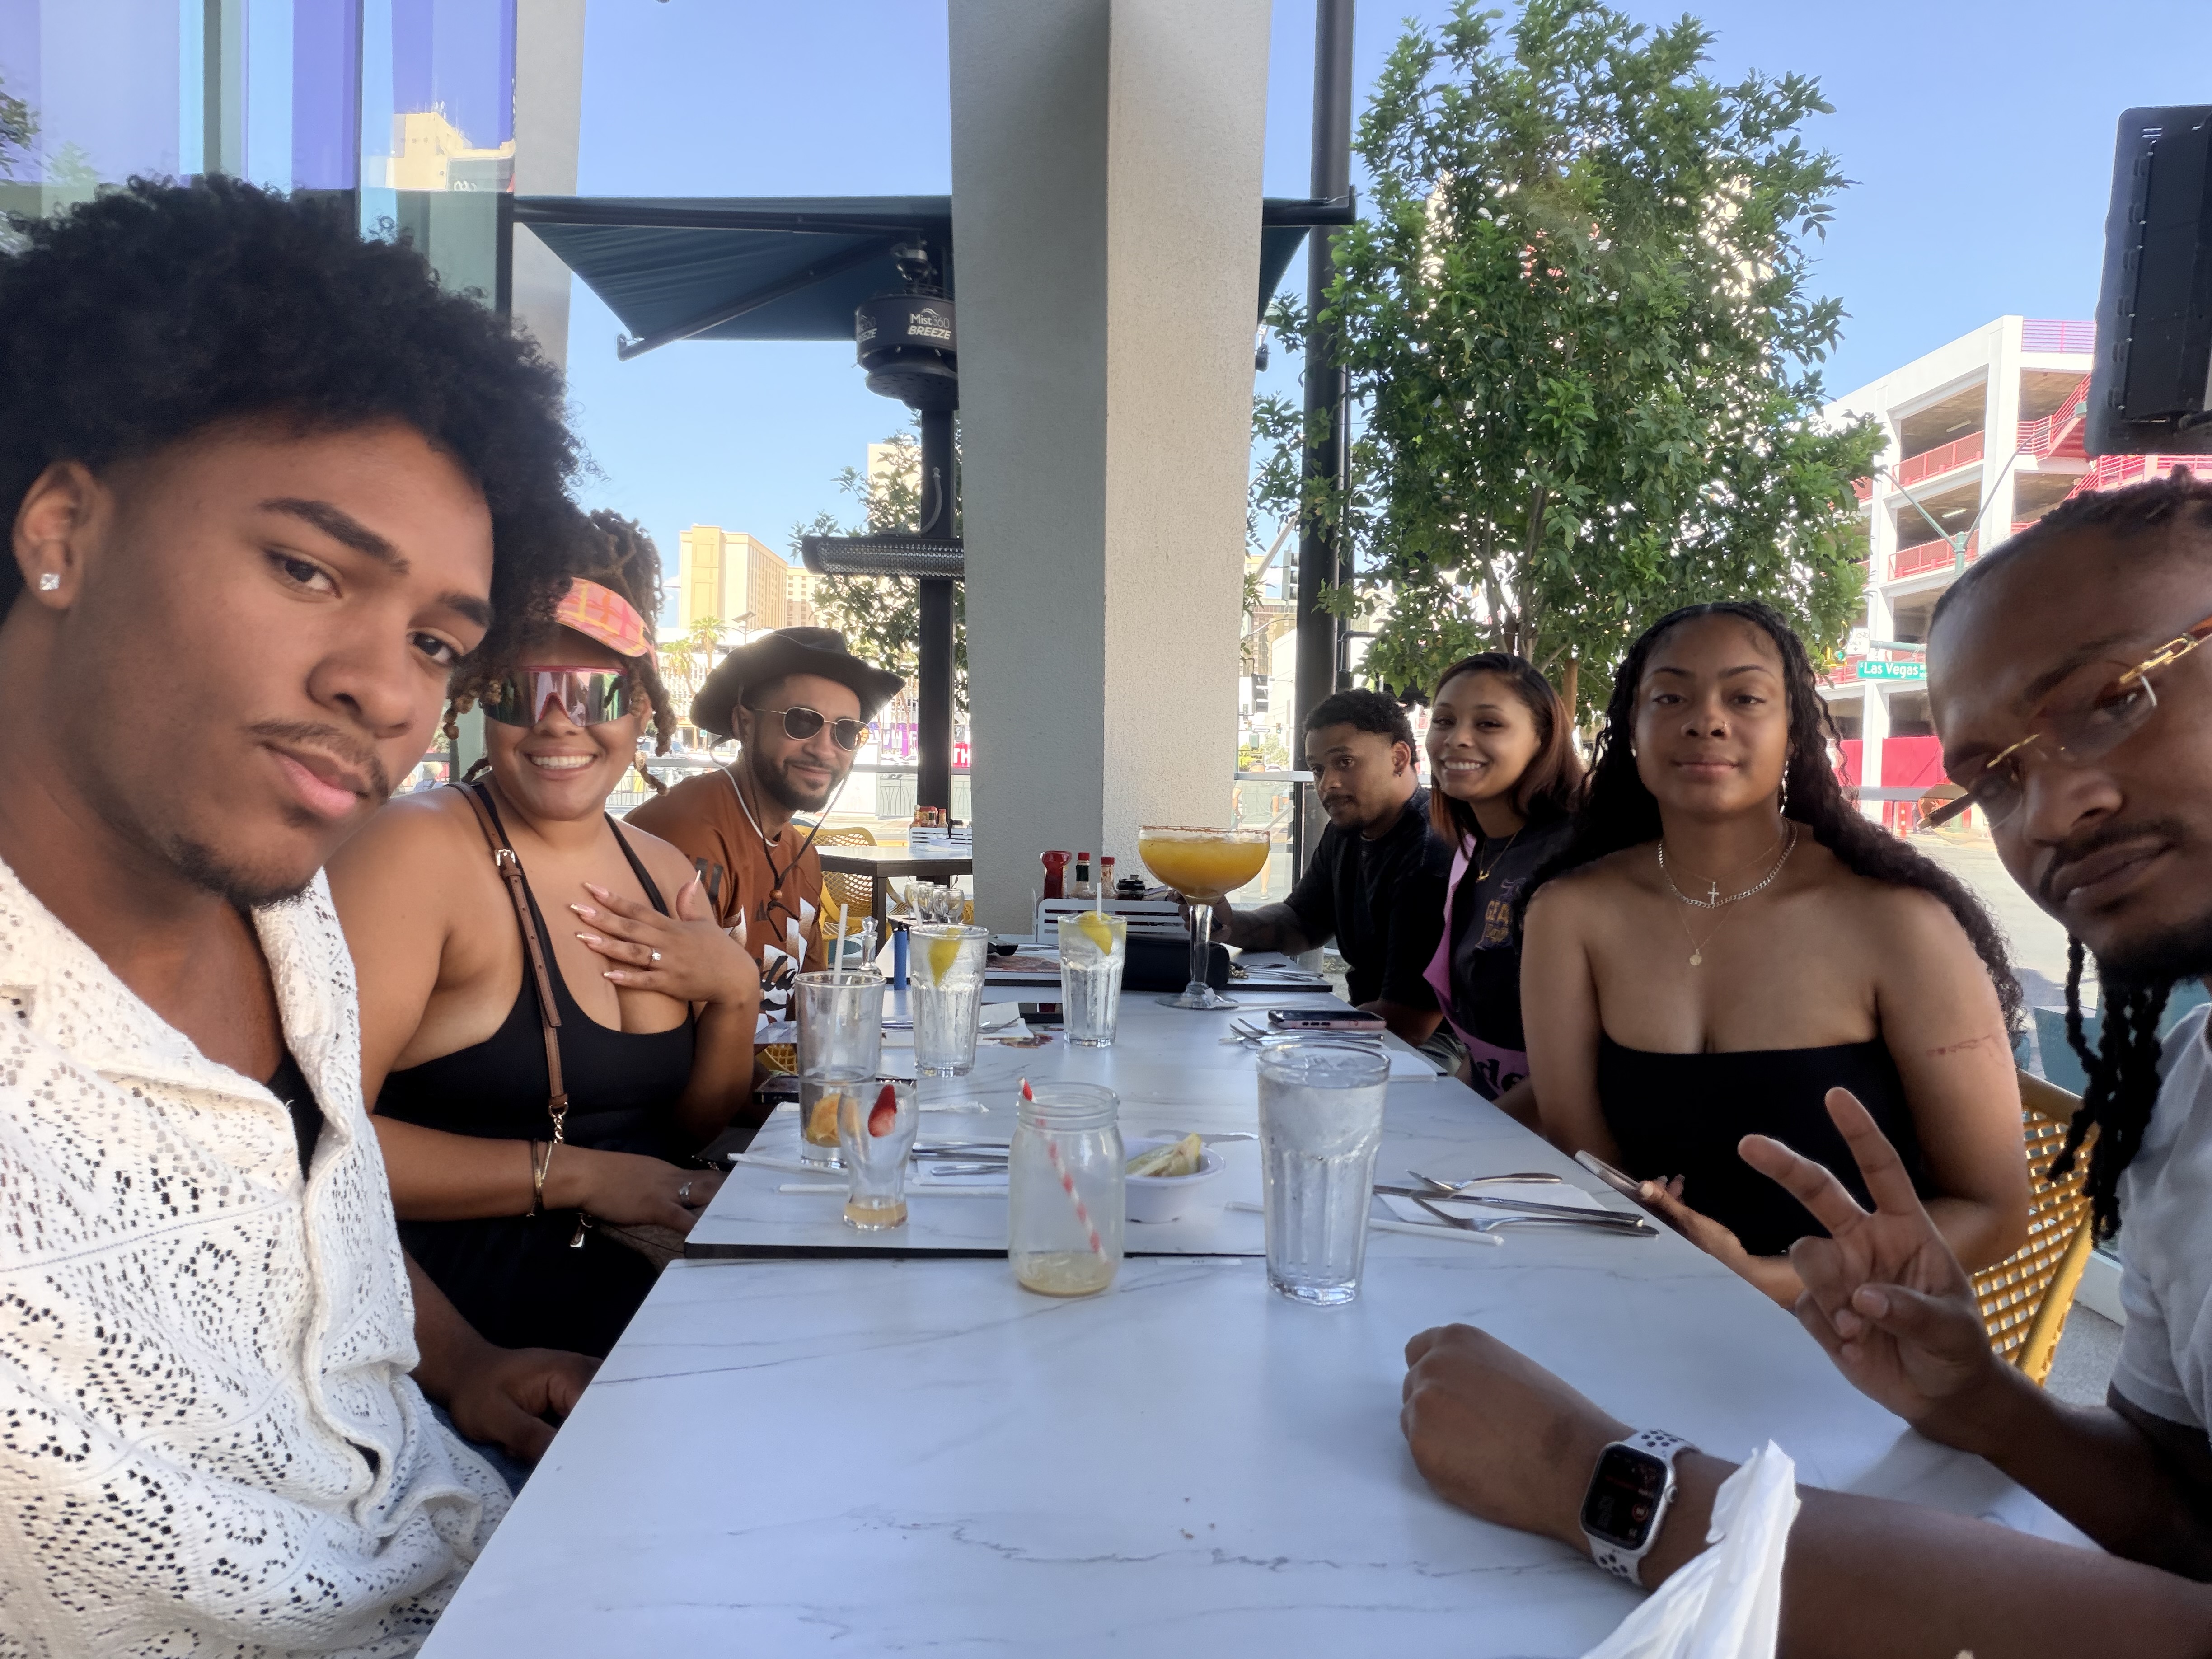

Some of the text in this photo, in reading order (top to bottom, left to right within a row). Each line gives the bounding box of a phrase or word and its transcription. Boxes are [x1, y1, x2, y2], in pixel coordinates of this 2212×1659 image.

[909, 313, 950, 328] Mist360
[908, 325, 952, 340] BREEZE
[1864, 662, 1883, 674] Las
[1885, 662, 1918, 679] Vegas
